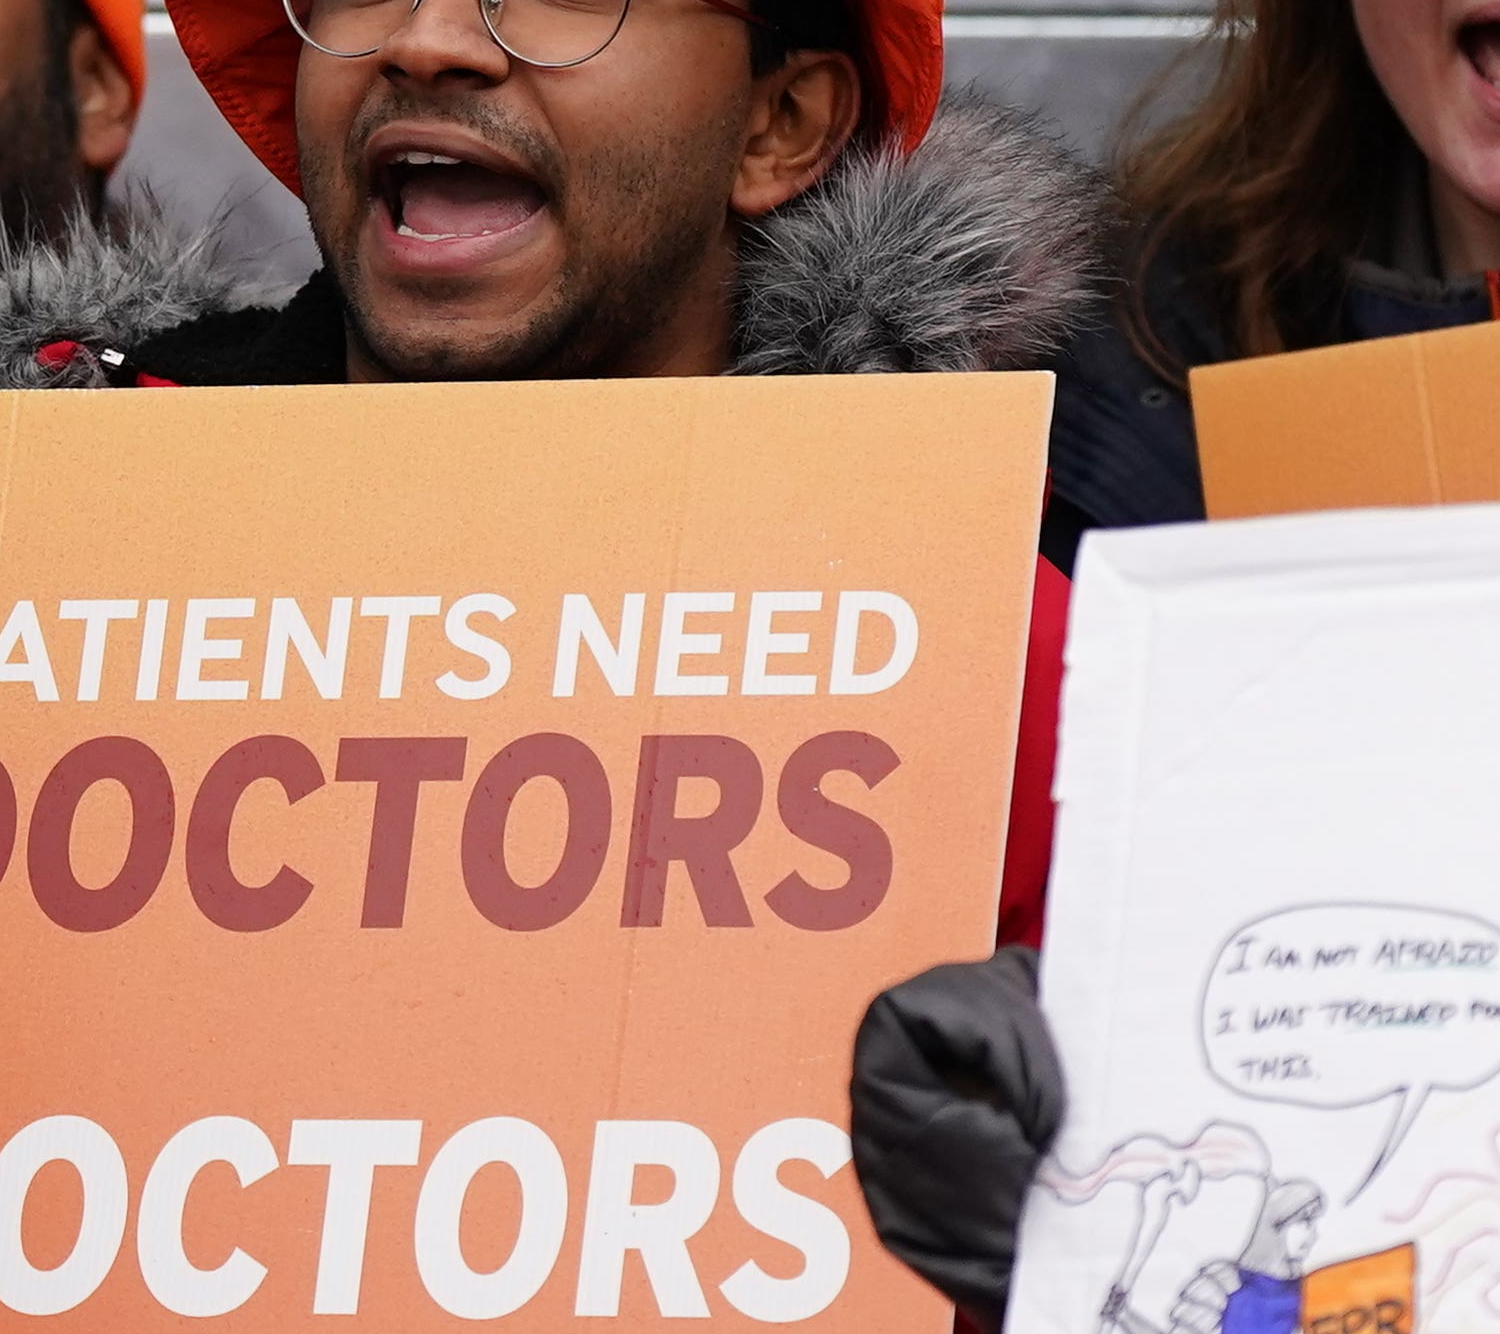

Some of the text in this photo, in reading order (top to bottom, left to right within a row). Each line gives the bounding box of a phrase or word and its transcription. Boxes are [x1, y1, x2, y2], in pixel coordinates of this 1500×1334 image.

[551, 589, 920, 698] NEED
[1225, 934, 1259, 975] I
[1313, 946, 1360, 970] NOT
[1374, 939, 1499, 967] AFRAID
[1215, 1011, 1237, 1036] I
[1251, 1006, 1310, 1034] WAS
[1320, 1001, 1460, 1027] TRAINED
